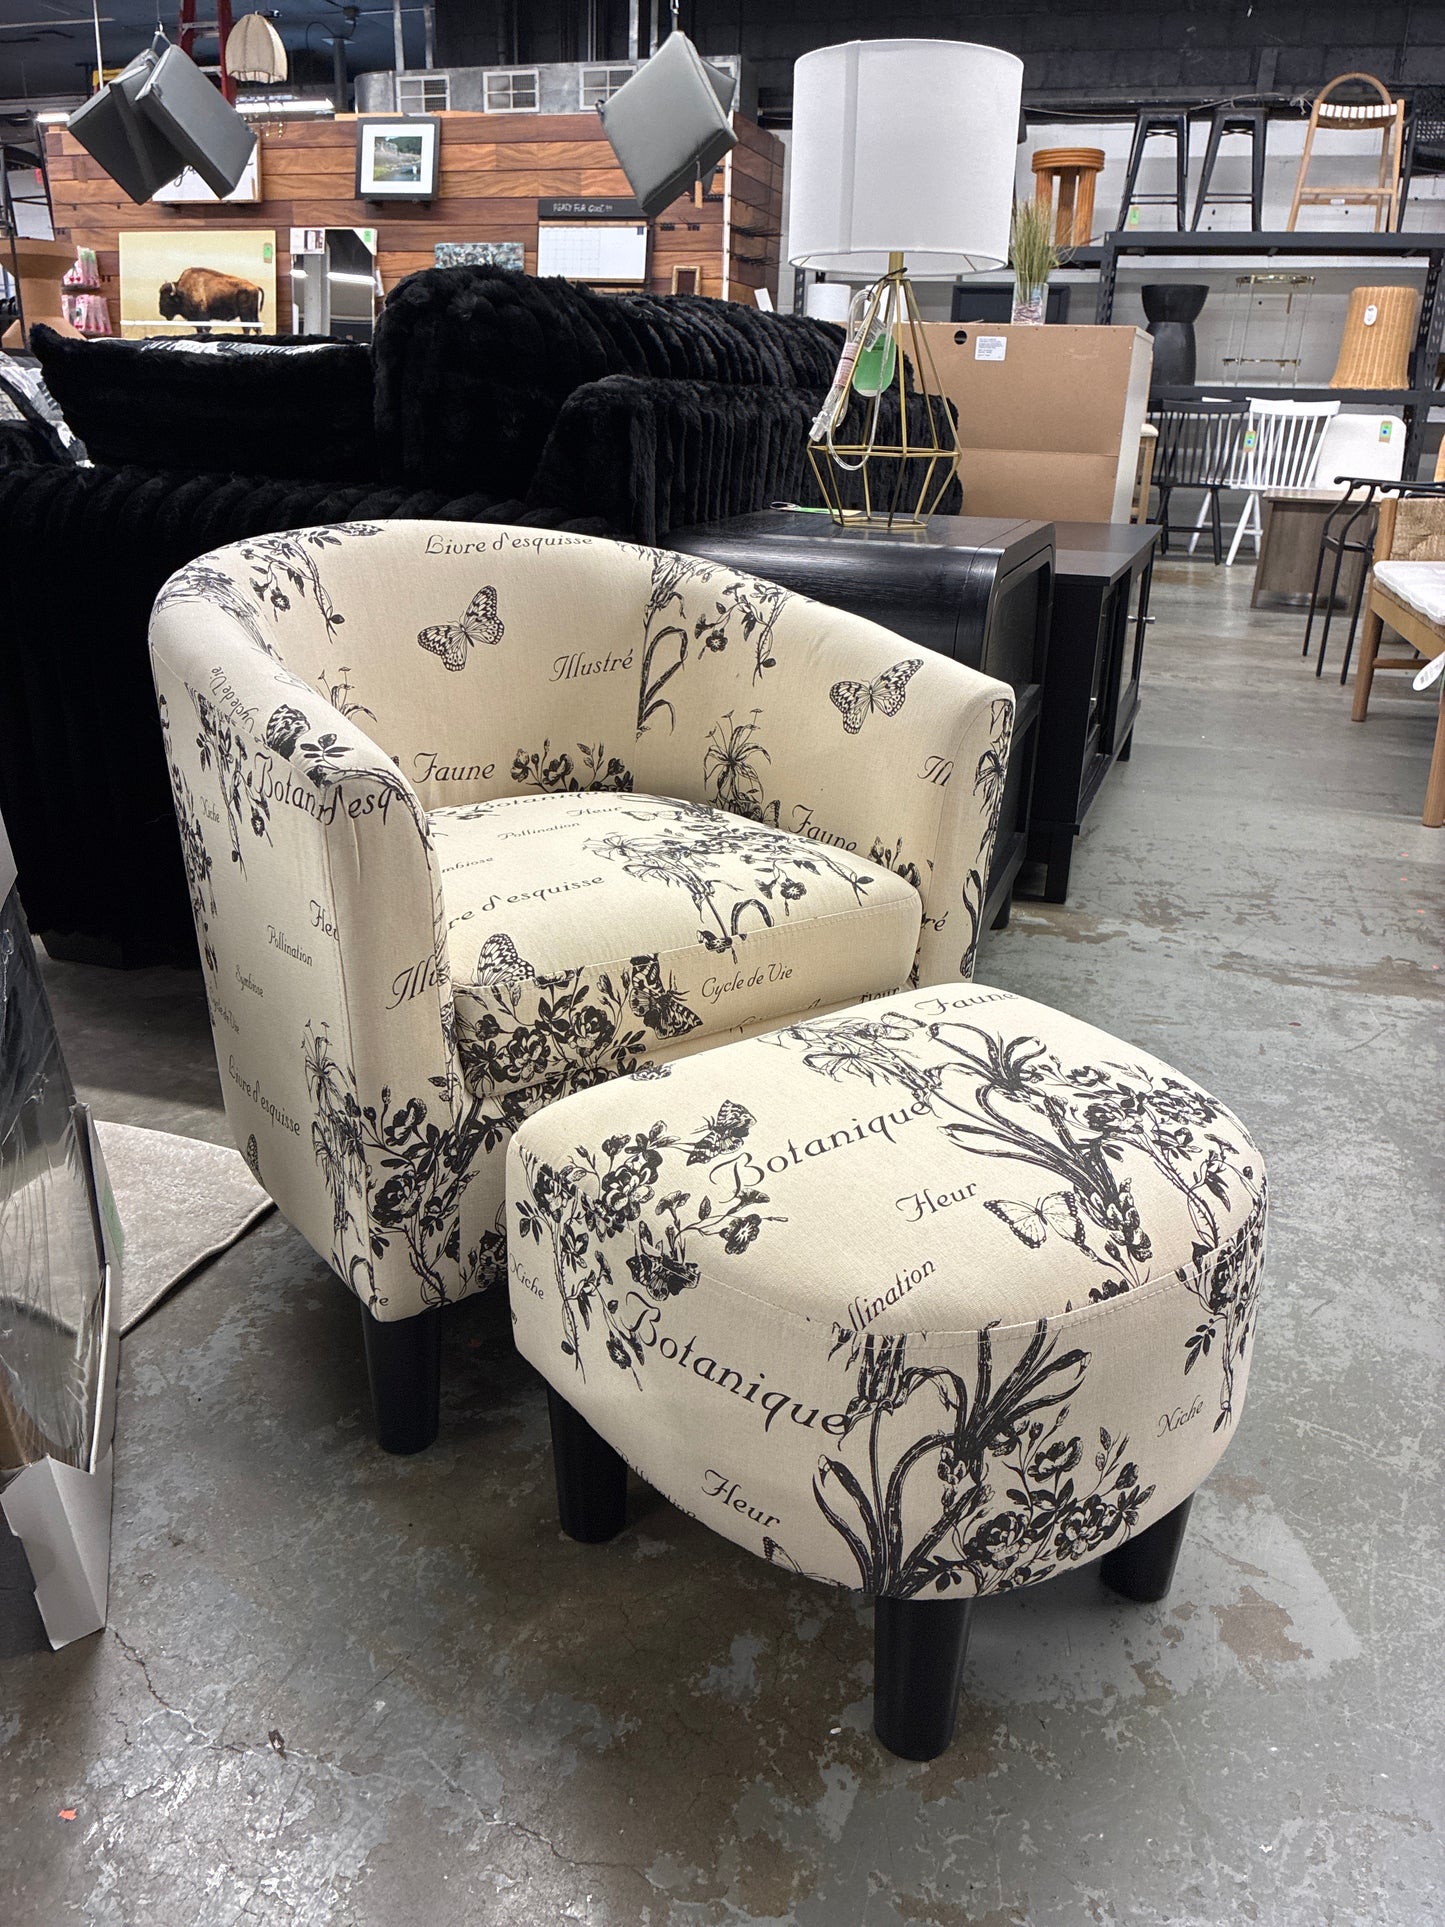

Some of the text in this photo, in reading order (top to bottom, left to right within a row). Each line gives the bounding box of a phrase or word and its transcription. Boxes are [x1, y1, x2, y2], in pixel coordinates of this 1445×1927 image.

[425, 533, 487, 555] Livre
[549, 648, 634, 682] Illustré
[411, 752, 495, 785] Faune
[497, 820, 581, 841] Pollination
[442, 857, 494, 874] mbiose
[267, 925, 313, 967] Pollination
[701, 962, 793, 1004] Cycle de Vie
[914, 993, 1019, 1015] Faune
[229, 1054, 251, 1097] Livre
[709, 1099, 932, 1203] Botanique
[896, 1182, 977, 1222] Fleur
[510, 1253, 544, 1300] Niche
[848, 1260, 936, 1331] llination
[618, 1290, 852, 1436] Botanique
[1157, 1394, 1204, 1438] Niche
[700, 1469, 781, 1528] Fleur
